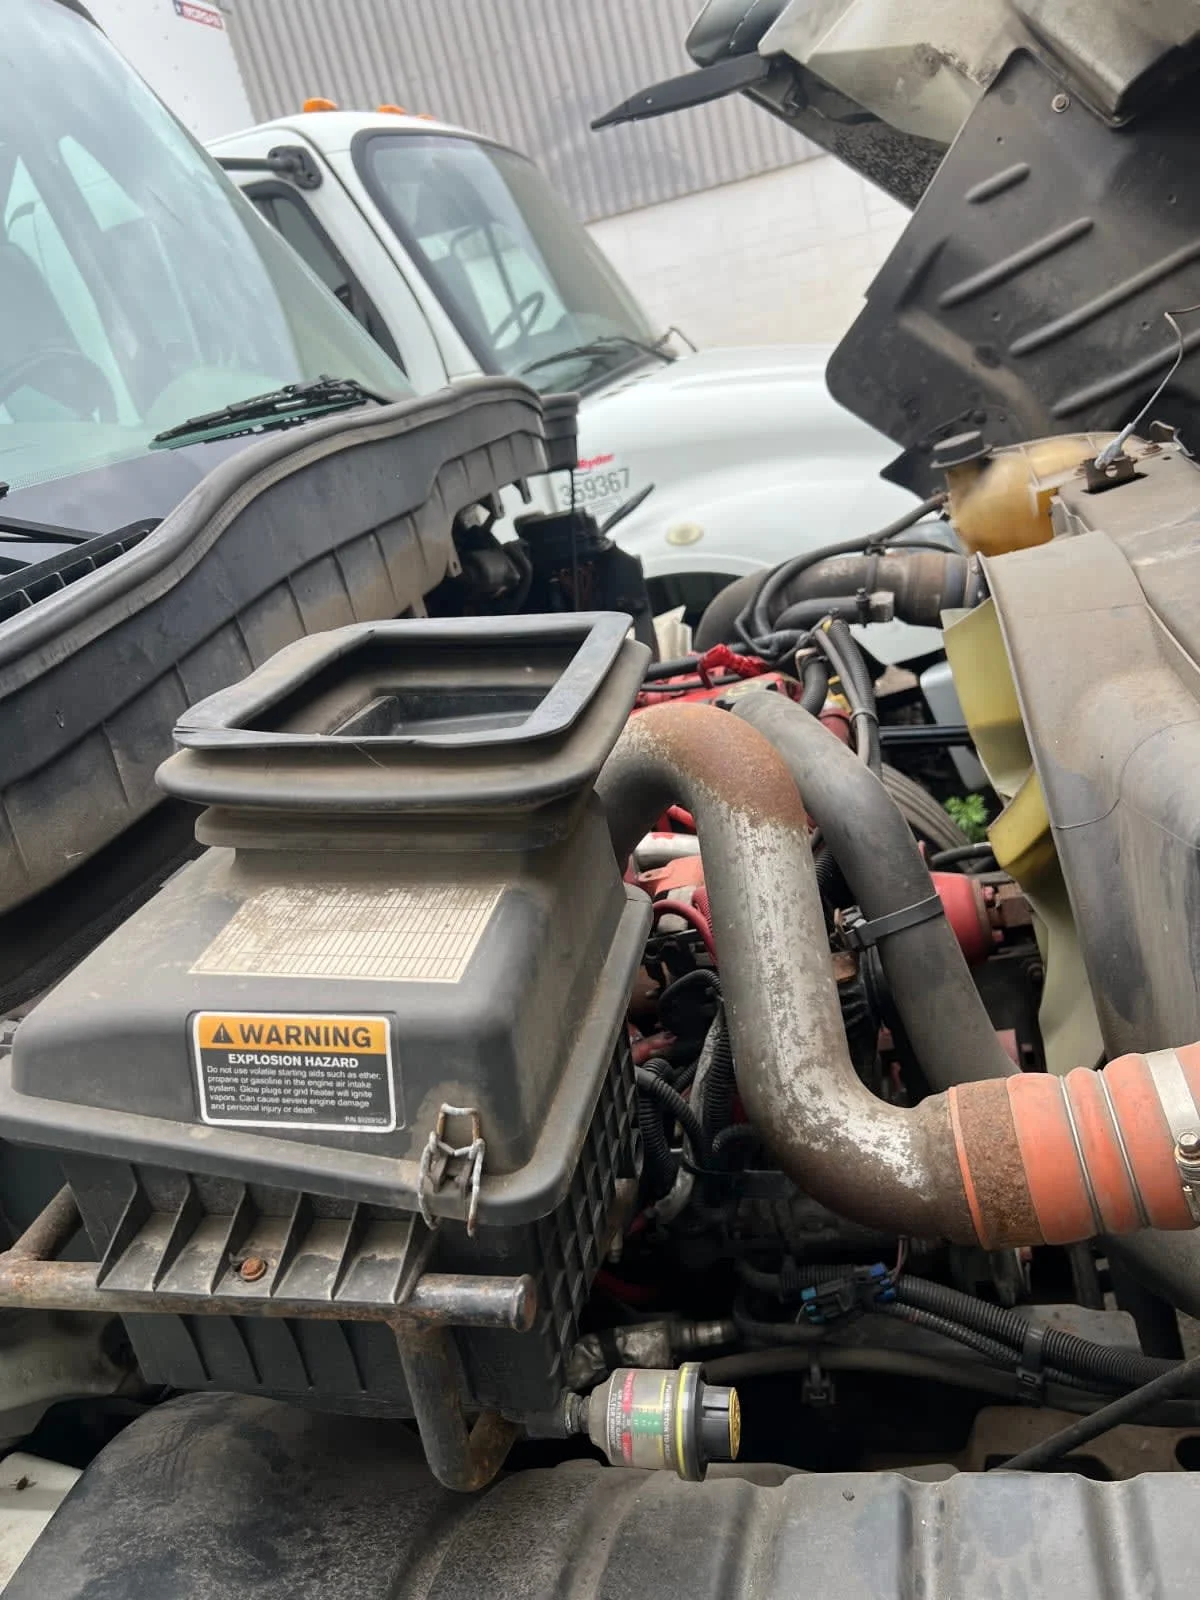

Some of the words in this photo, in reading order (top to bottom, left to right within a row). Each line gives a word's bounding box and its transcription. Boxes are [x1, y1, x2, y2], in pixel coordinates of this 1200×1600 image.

[239, 1023, 372, 1048] WARNING
[228, 1053, 302, 1067] EXPLOSION
[304, 1056, 360, 1069] HAZARD
[207, 1065, 218, 1073] Do
[249, 1067, 277, 1075] volatile
[278, 1069, 307, 1078] starting
[207, 1076, 239, 1084] propane
[249, 1077, 283, 1086] gasoline
[292, 1078, 306, 1086] the
[307, 1080, 334, 1088] engine
[240, 1085, 260, 1093] Glow
[261, 1087, 283, 1096] plugs
[309, 1088, 335, 1096] heater
[351, 1090, 374, 1099] ignite
[239, 1094, 256, 1102] Can
[281, 1097, 308, 1105] severe
[309, 1099, 336, 1107] engine
[337, 1099, 371, 1108] damage
[261, 1105, 283, 1114] injury
